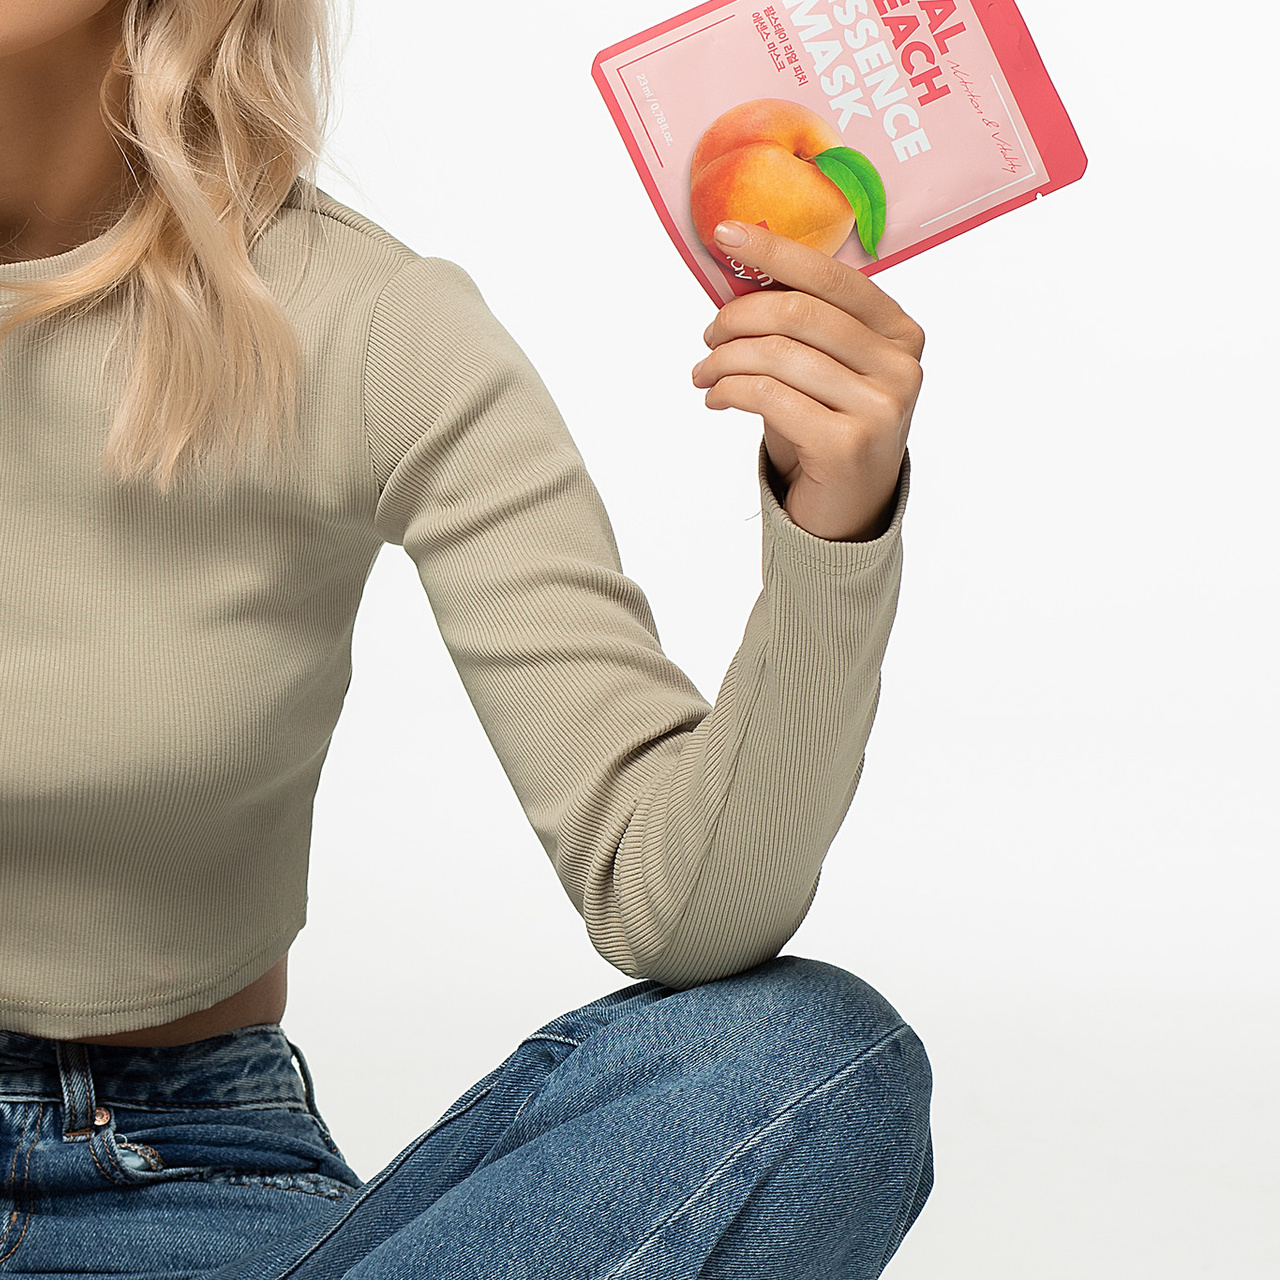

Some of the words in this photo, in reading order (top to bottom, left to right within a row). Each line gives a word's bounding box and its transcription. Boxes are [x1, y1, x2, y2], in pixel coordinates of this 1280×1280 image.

[752, 11, 771, 42] 에센스
[767, 42, 786, 72] 마스크
[763, 5, 789, 44] 팜스테이
[783, 44, 799, 65] 리얼
[793, 65, 809, 86] 피치
[726, 255, 752, 280] ay
